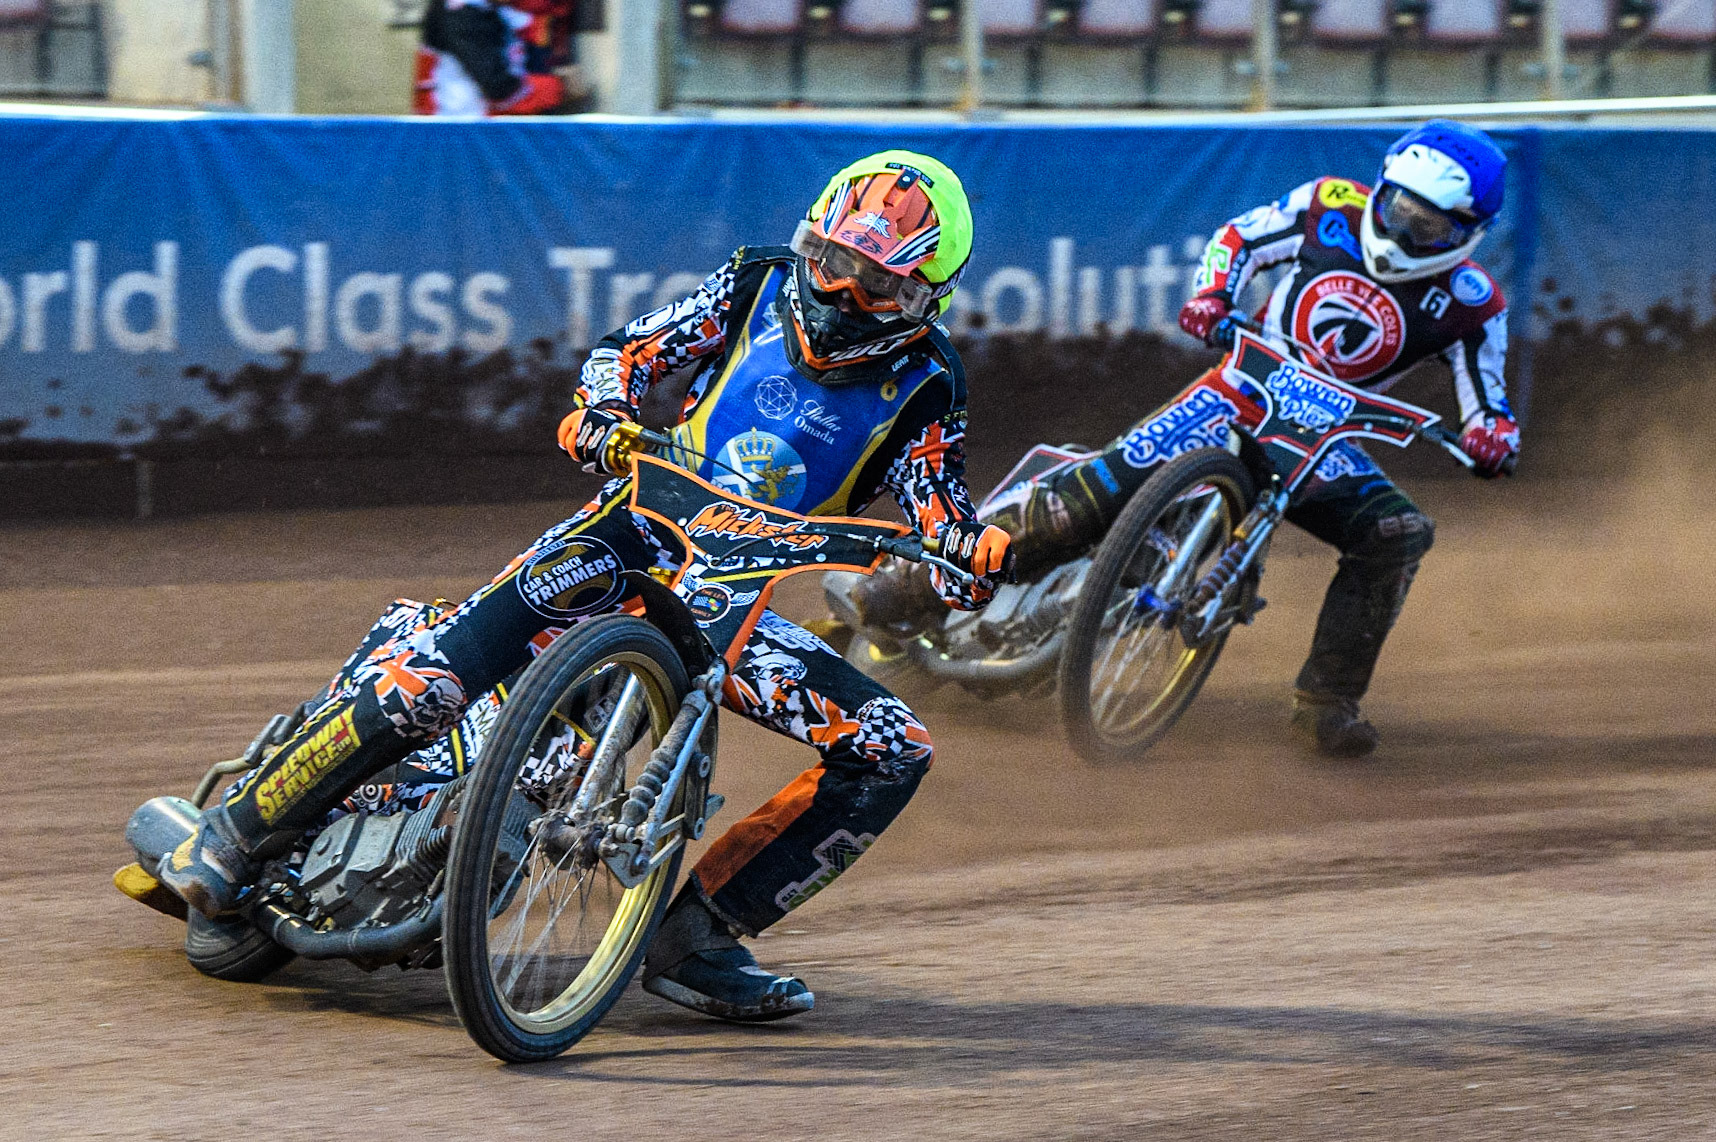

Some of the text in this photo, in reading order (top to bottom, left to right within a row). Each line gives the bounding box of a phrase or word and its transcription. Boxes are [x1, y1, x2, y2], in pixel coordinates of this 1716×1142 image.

[0, 240, 179, 353] rld
[220, 241, 512, 353] Class
[1270, 365, 1353, 412] Bowen
[794, 415, 836, 445] Omada
[800, 399, 842, 433] Stellar
[1126, 389, 1220, 465] Bowen
[523, 556, 584, 594] CAR & COACH
[528, 554, 617, 606] TRIMMERS
[255, 701, 361, 826] SPEEDWAY
